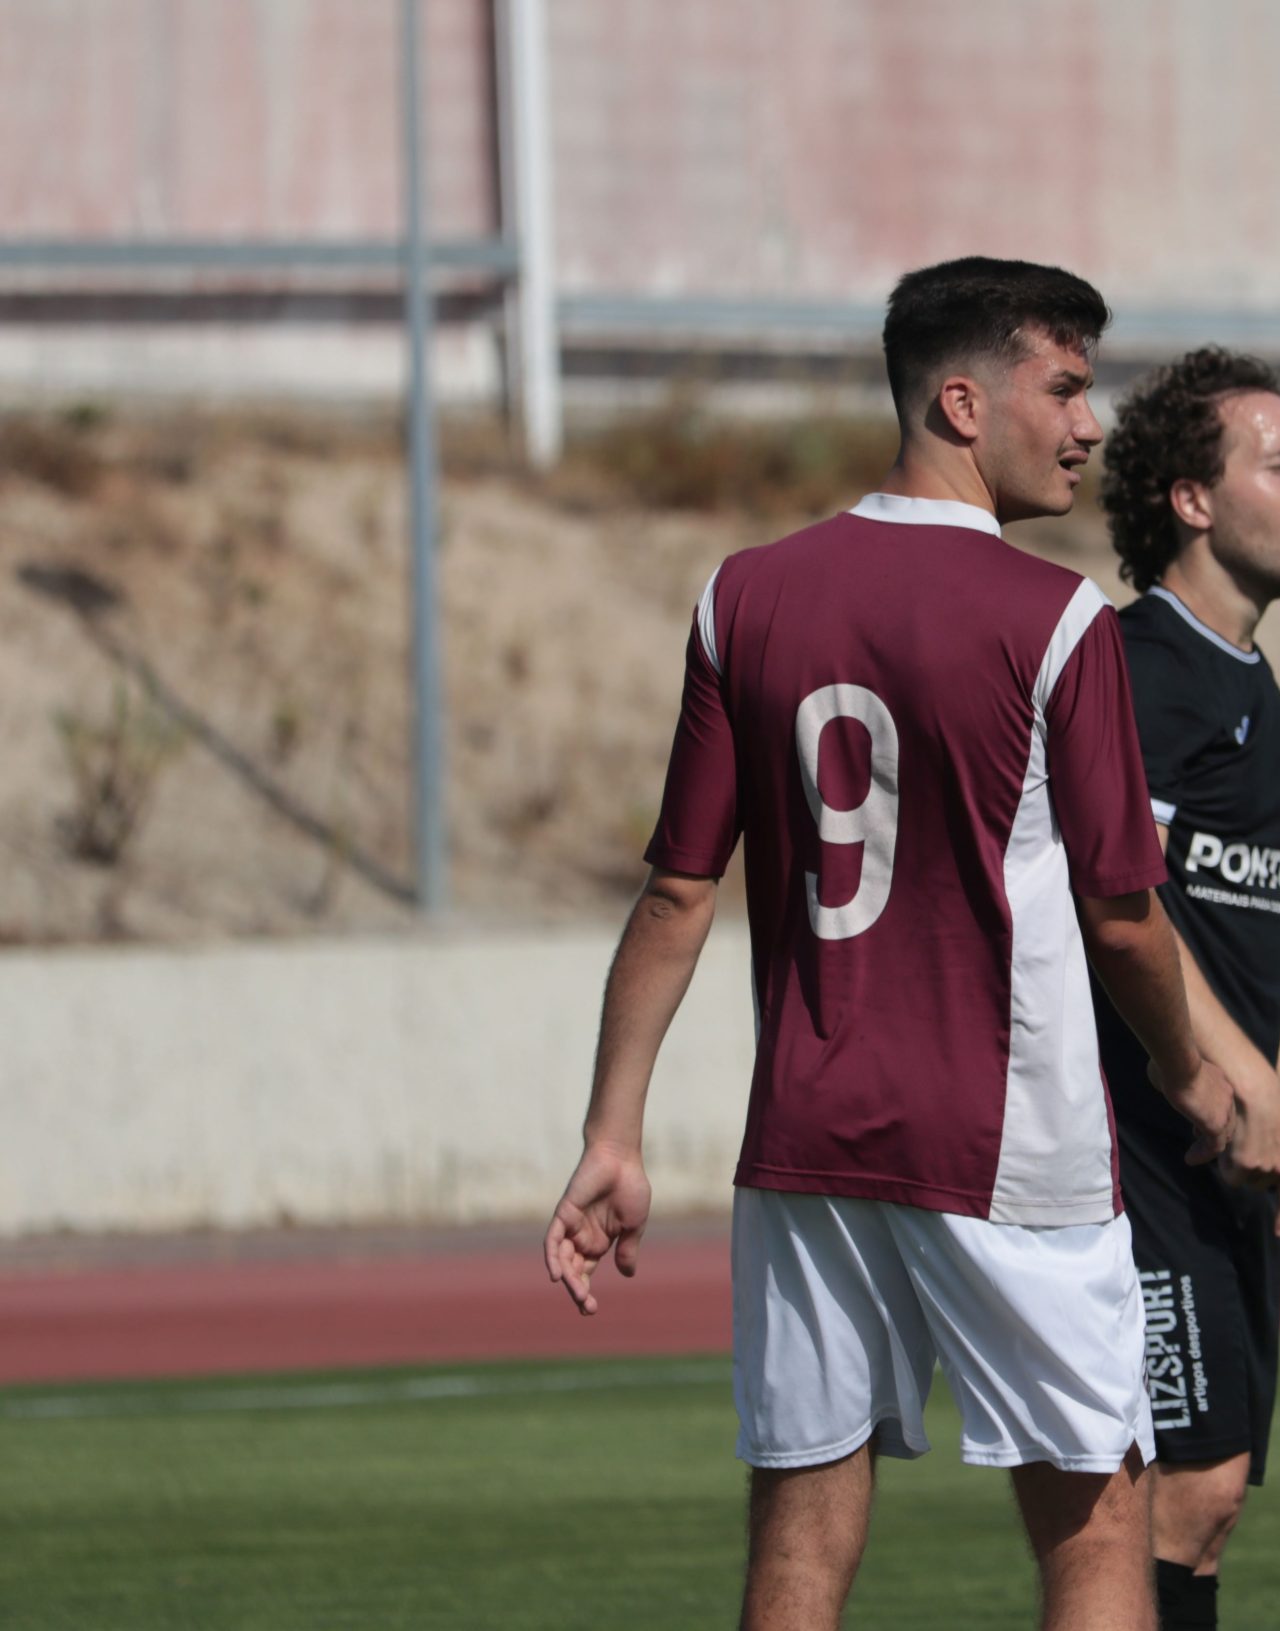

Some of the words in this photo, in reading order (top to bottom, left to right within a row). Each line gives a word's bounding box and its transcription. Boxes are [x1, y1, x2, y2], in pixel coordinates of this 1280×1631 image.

[796, 683, 900, 941] 9
[1186, 885, 1249, 908] MATERIAIS
[1137, 1265, 1192, 1429] LIZSPORT
[1180, 1274, 1203, 1359] desportivos
[1192, 1361, 1210, 1412] artigos
